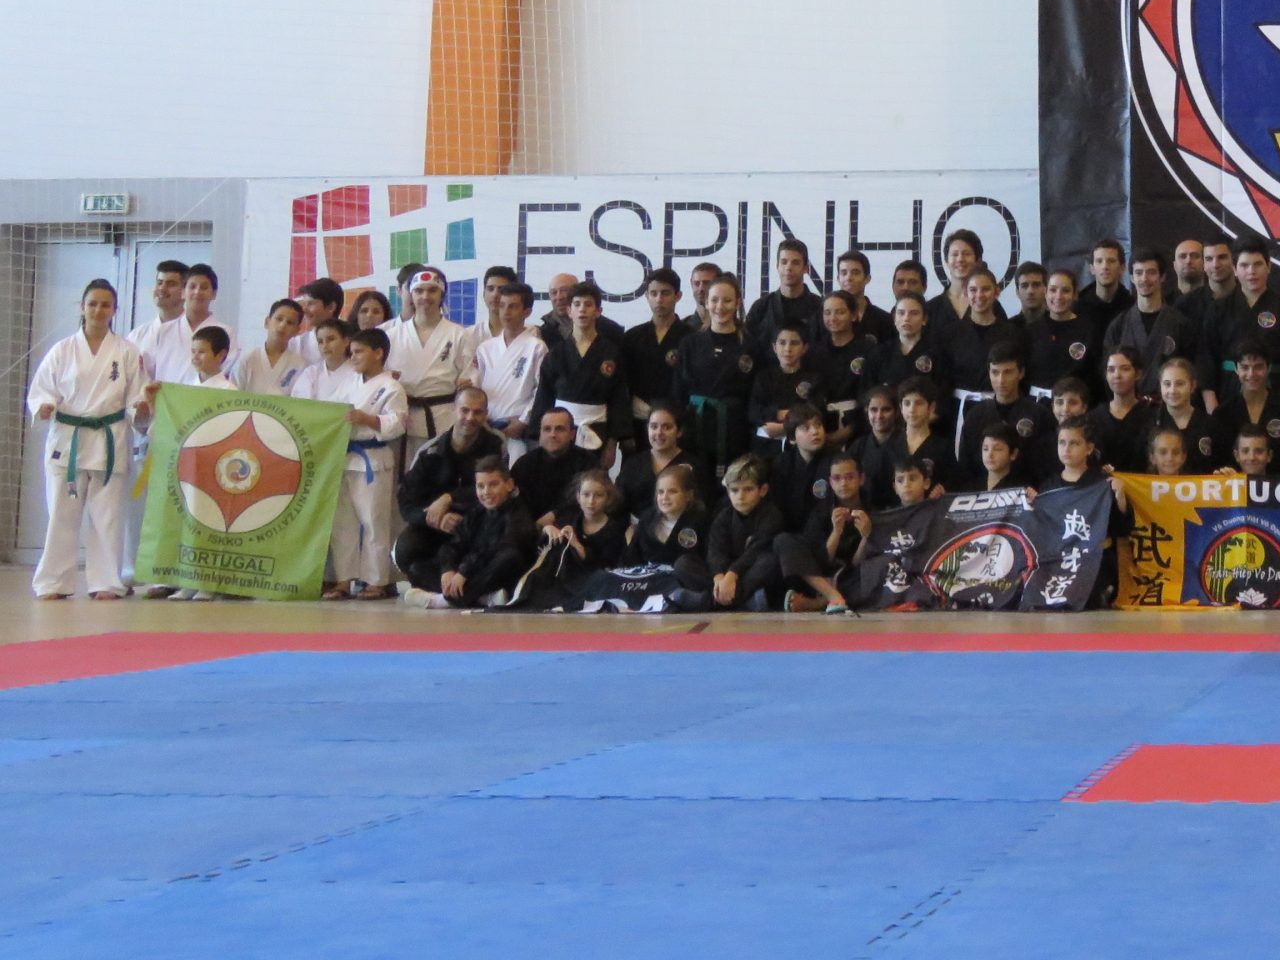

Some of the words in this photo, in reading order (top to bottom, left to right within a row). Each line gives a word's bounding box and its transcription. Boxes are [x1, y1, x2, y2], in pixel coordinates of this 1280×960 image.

[516, 196, 1021, 303] ESPINHO
[217, 398, 287, 417] KYOKUSHIN
[287, 416, 314, 457] KARATE
[182, 548, 268, 573] PORTUGAL
[620, 582, 649, 592] 1974
